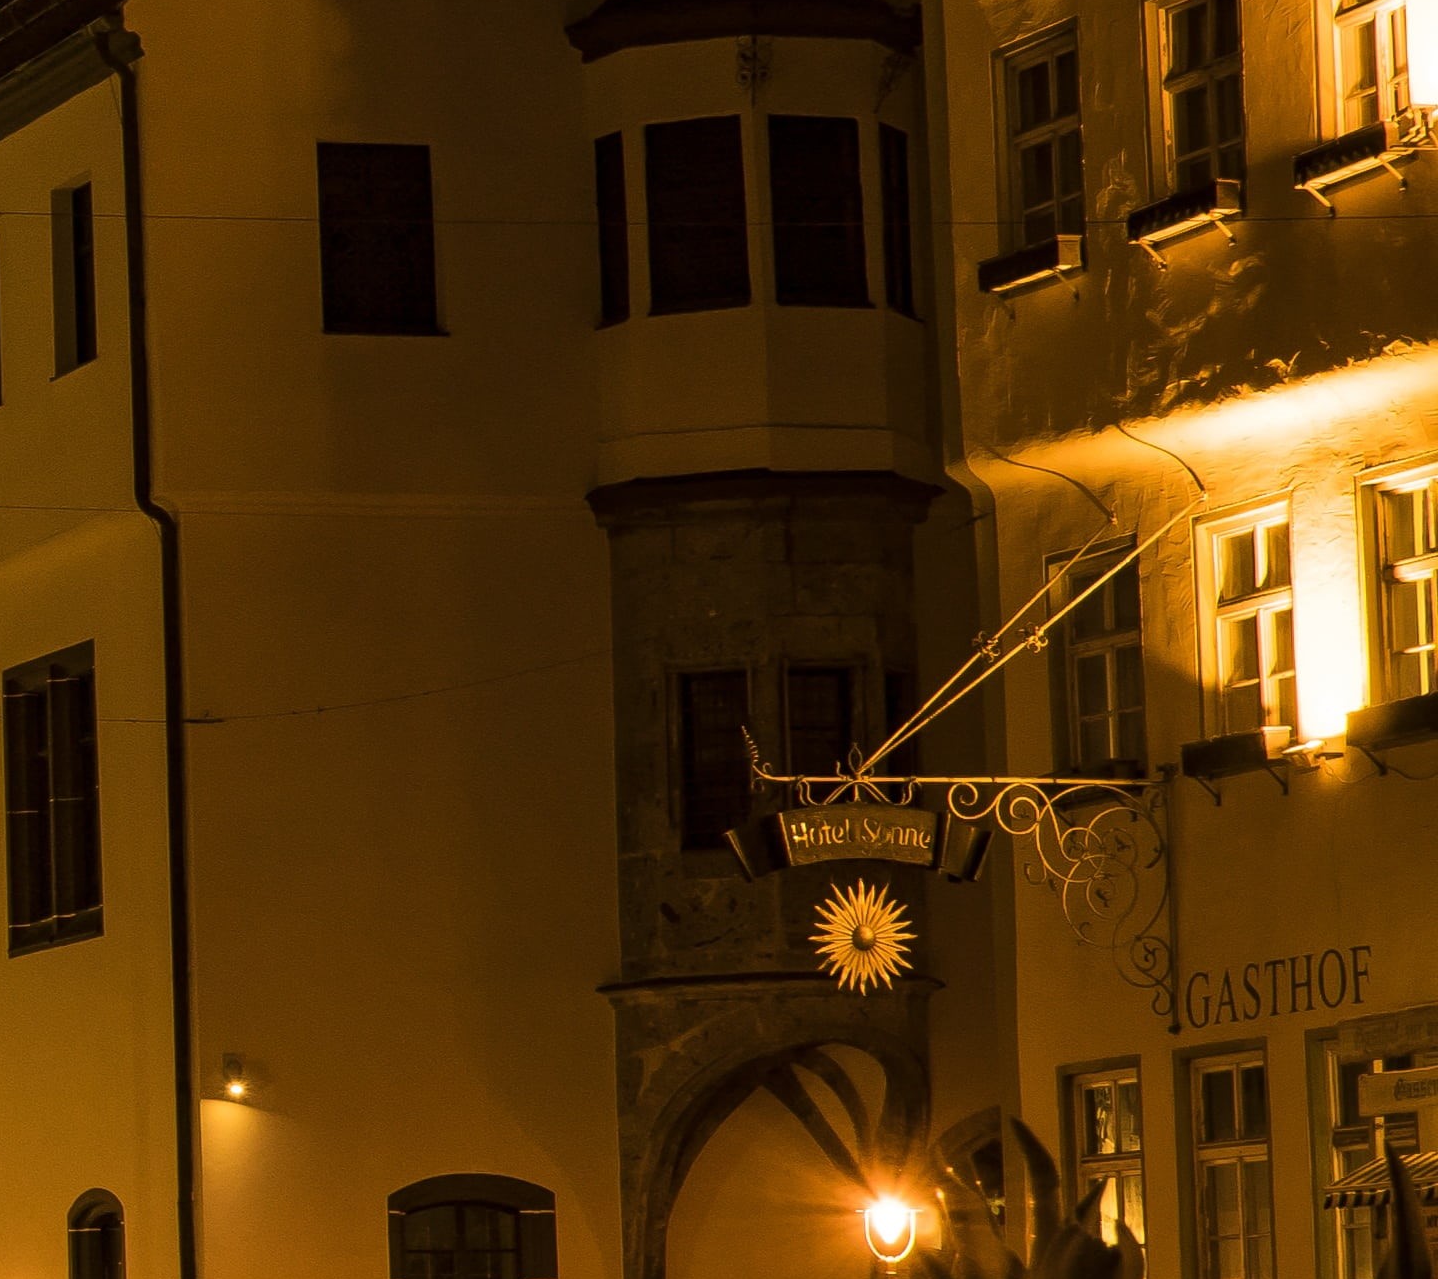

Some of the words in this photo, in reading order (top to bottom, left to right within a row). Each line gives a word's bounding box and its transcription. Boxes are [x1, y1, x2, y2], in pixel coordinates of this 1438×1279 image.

[790, 818, 850, 849] Hotel
[862, 817, 932, 850] Sonne
[1185, 945, 1373, 1030] GASTHOF
